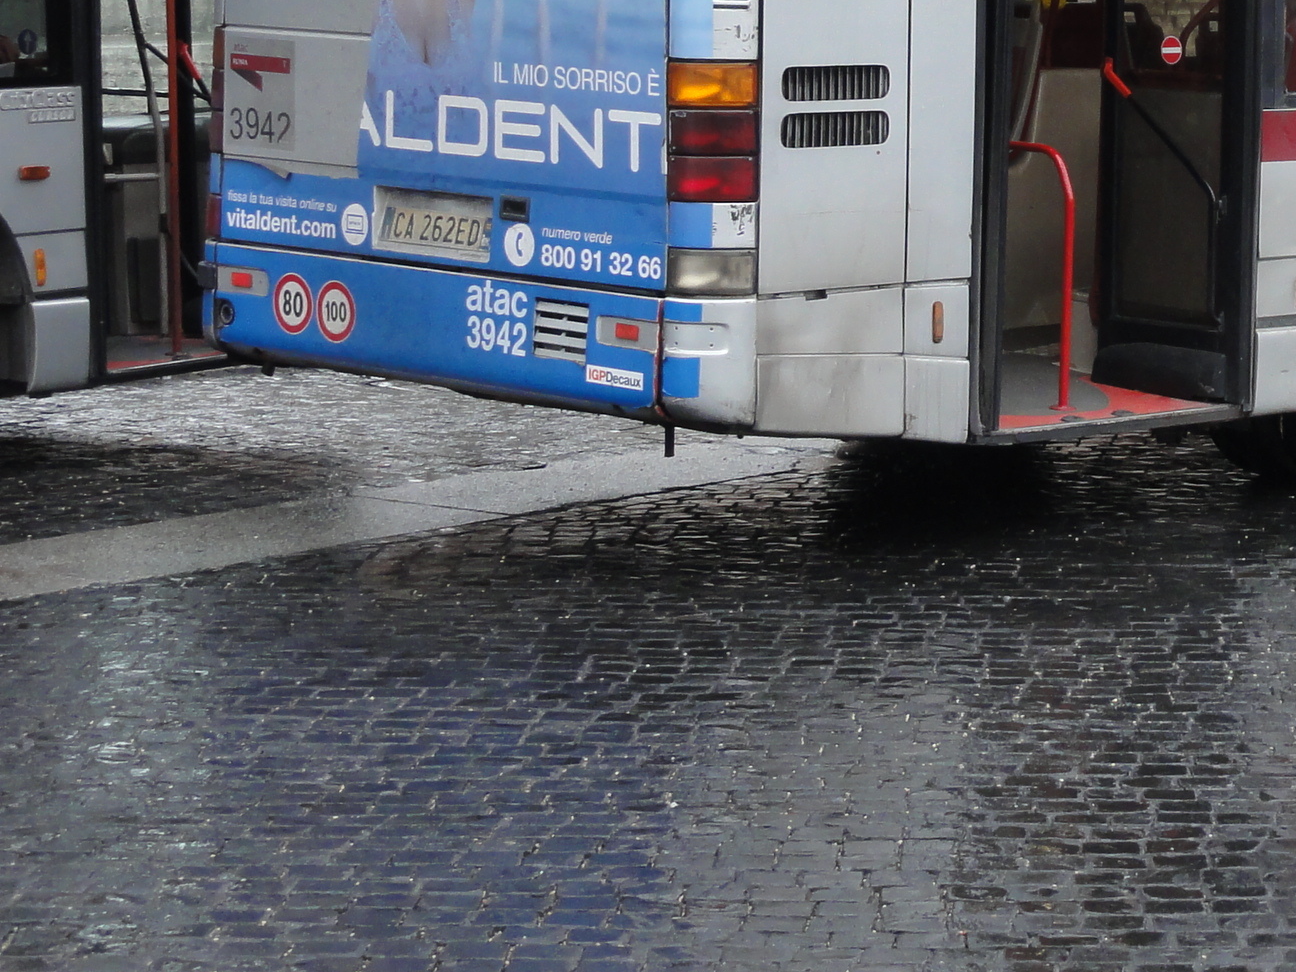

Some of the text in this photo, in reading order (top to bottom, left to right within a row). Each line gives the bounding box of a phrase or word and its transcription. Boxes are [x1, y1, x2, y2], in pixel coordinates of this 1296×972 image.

[494, 61, 660, 96] IL MIO SORRISO È
[230, 107, 291, 144] 3942
[227, 189, 337, 212] fissa la tua visita online su
[226, 207, 336, 239] vitaldent.com
[393, 212, 481, 246] CA 262ED
[541, 227, 613, 245] numero verde
[541, 244, 662, 280] 800 91 32 66
[283, 289, 303, 318] 80
[325, 300, 347, 323] 100
[465, 279, 528, 318] atac
[466, 314, 528, 357] 3942
[588, 367, 642, 389] IGPDecaux
